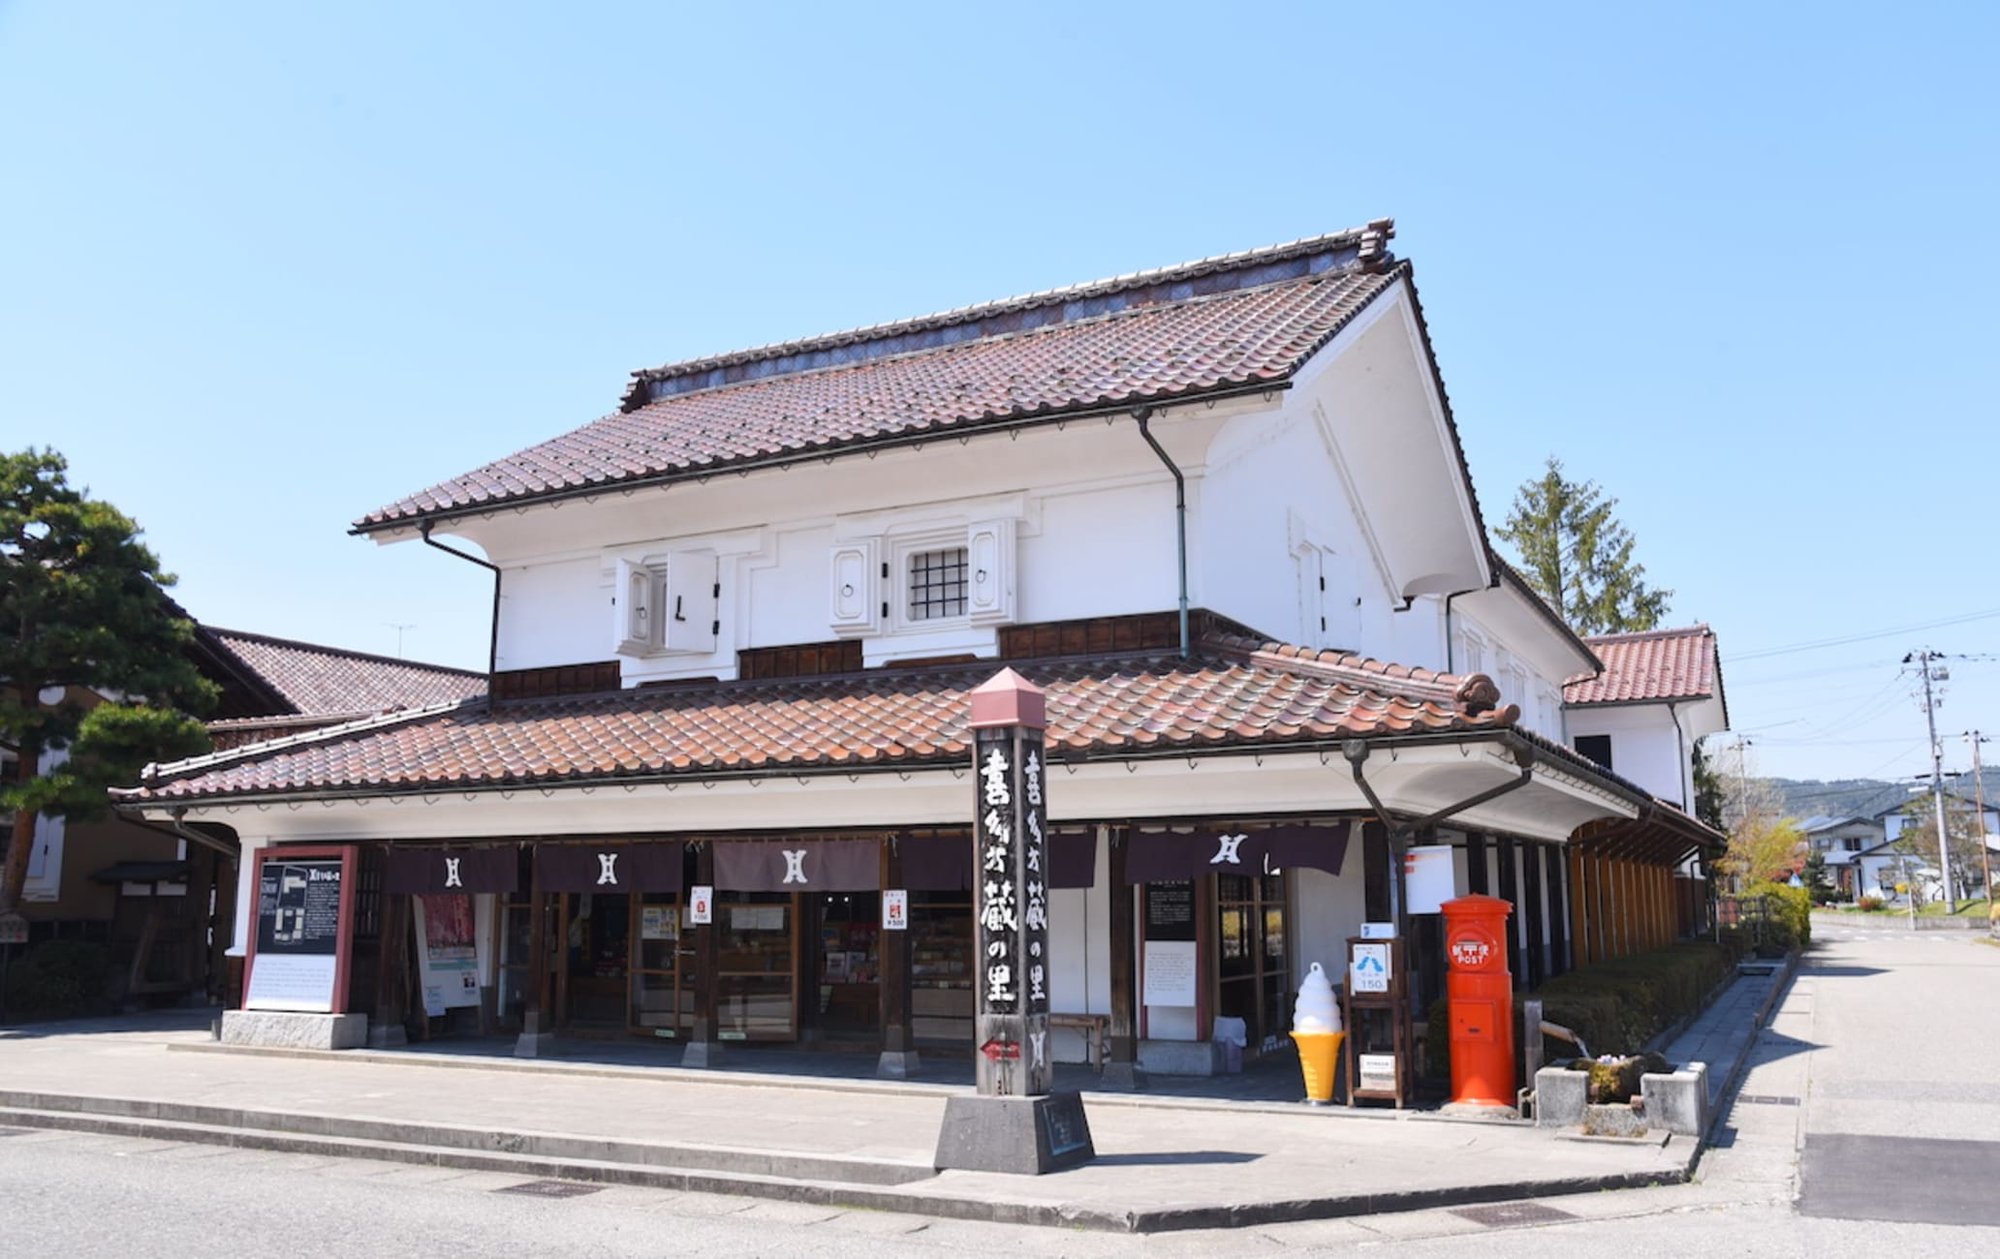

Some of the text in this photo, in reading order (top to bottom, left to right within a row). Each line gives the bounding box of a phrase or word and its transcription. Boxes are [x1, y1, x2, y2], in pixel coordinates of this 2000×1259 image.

[980, 748, 1018, 1001] 喜多方蔵の里
[1024, 749, 1048, 1001] 喜多方蔵の里
[1458, 955, 1483, 964] POST
